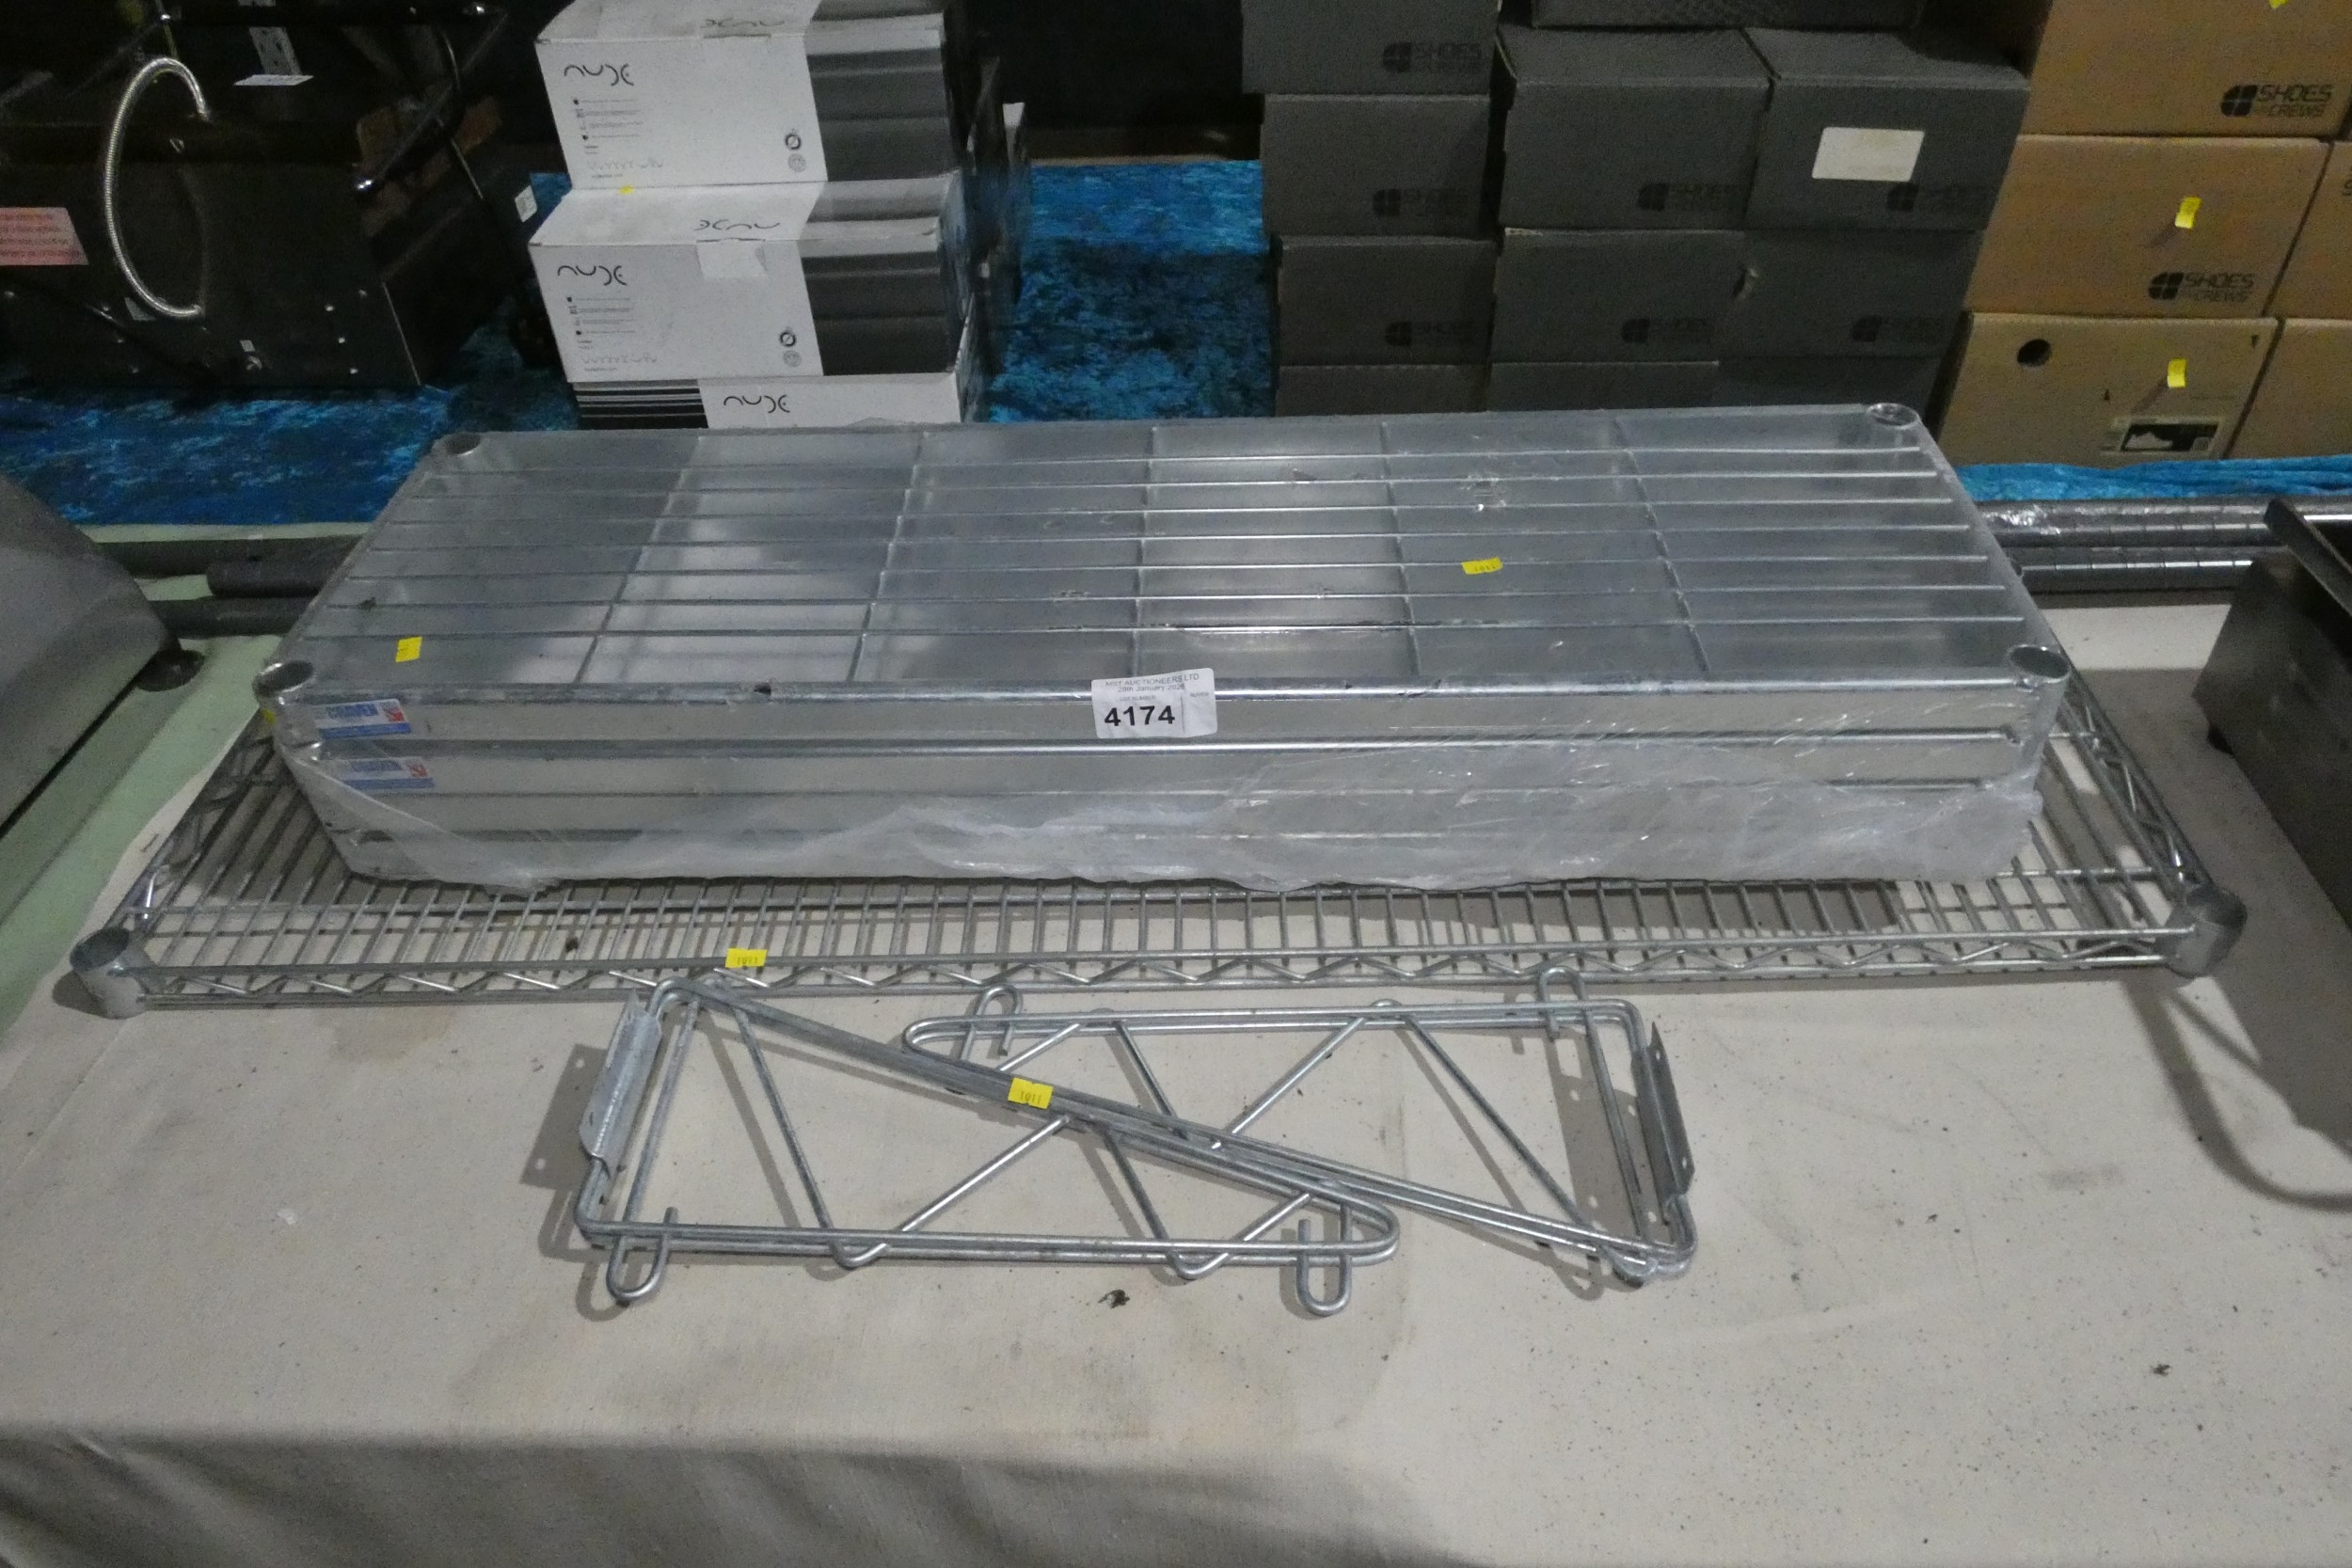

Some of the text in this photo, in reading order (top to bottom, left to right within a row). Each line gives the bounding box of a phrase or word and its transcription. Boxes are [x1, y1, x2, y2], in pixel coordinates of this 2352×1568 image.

[2257, 84, 2333, 102] SHOES
[2184, 272, 2255, 288] SHOES
[1124, 674, 1183, 686] AUCTIONEERS
[1184, 673, 1200, 682] LTD
[1104, 705, 1176, 727] 4174
